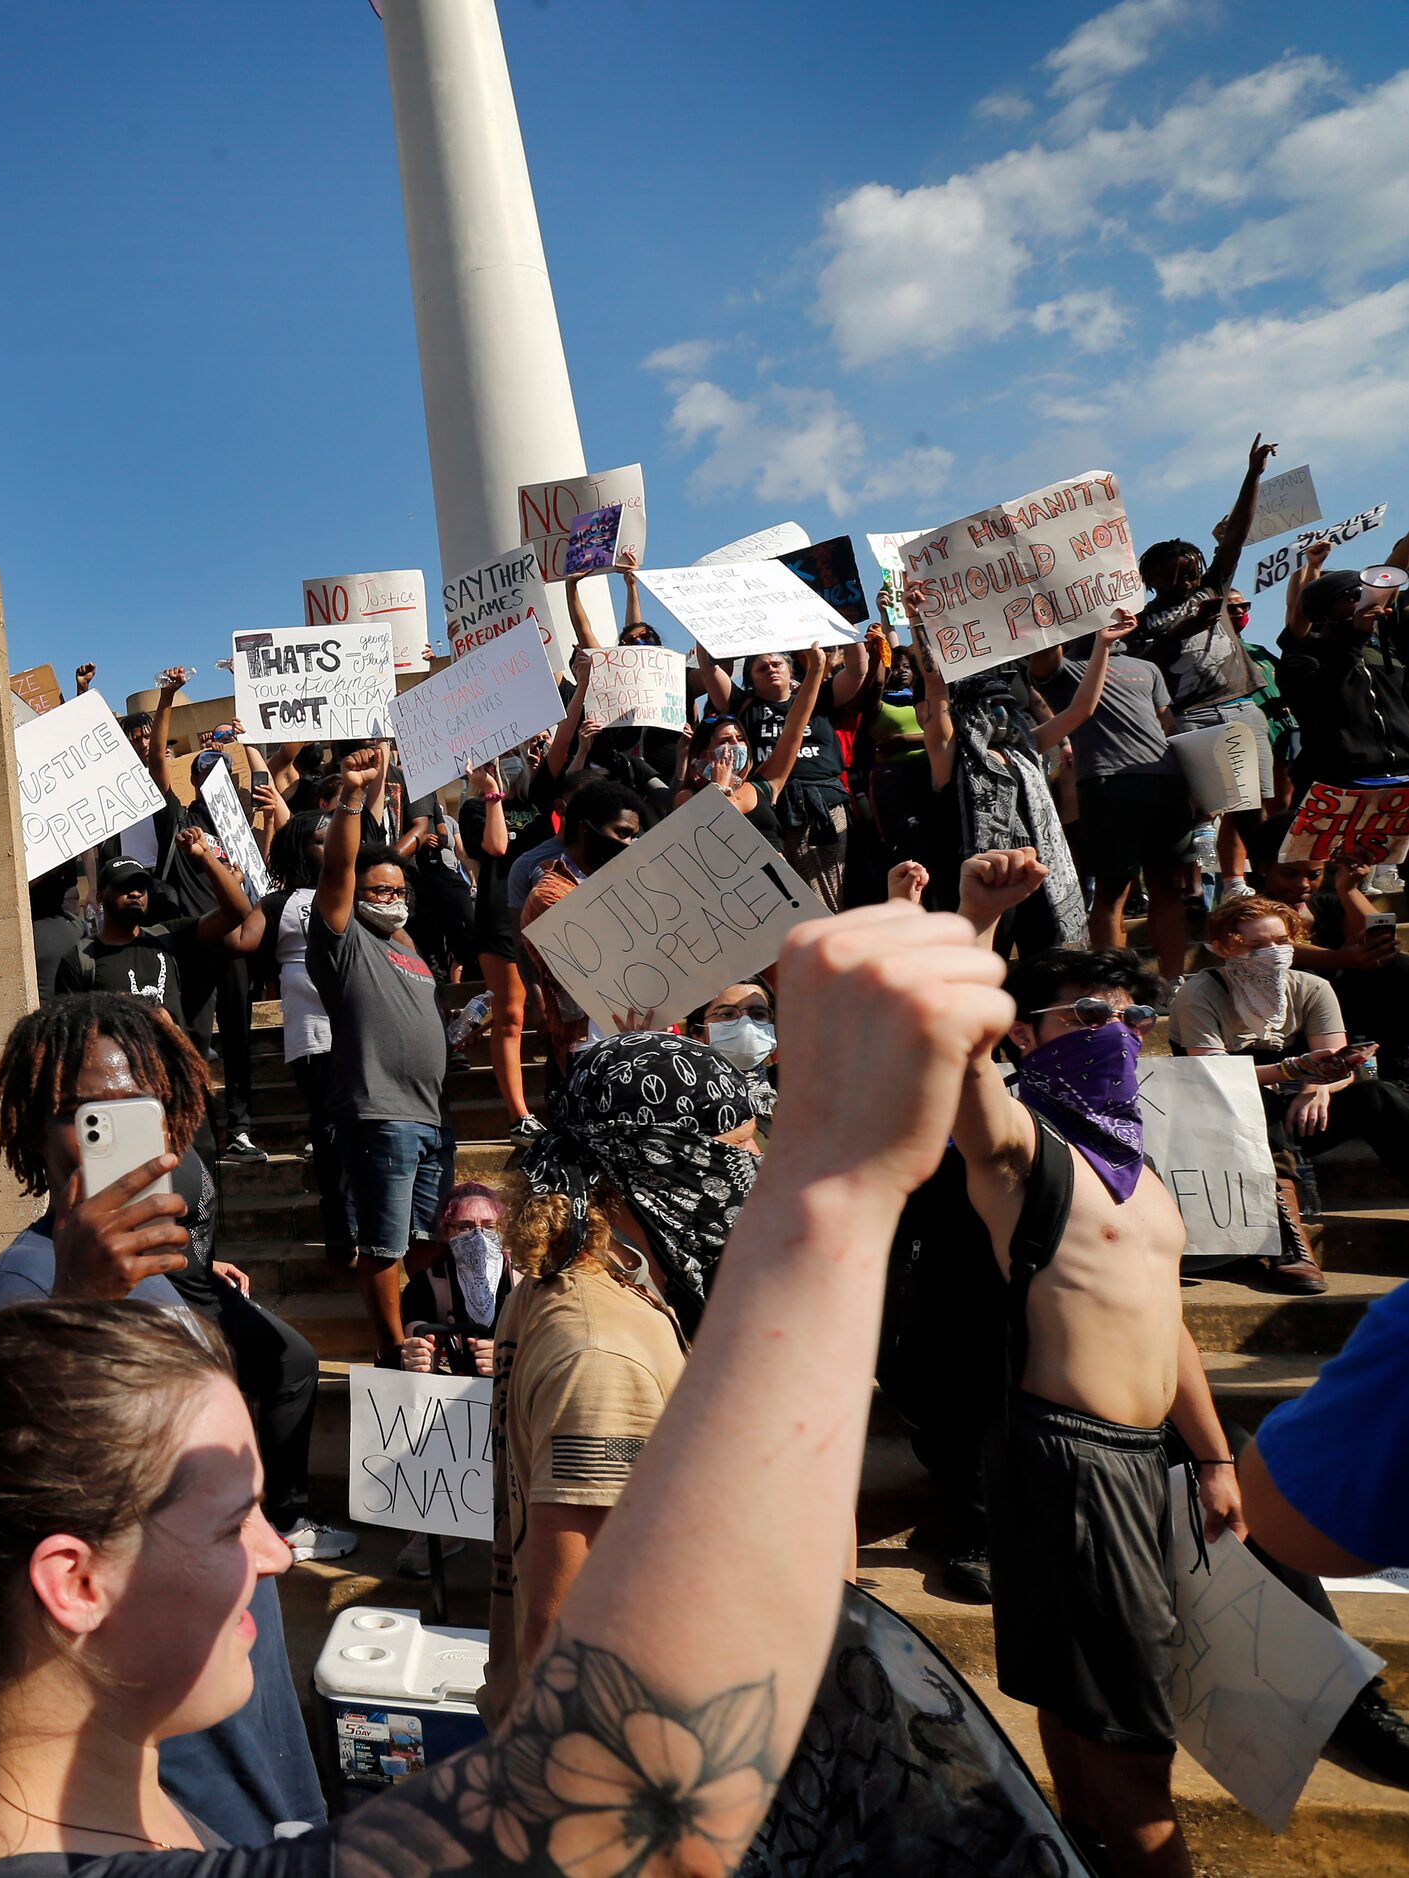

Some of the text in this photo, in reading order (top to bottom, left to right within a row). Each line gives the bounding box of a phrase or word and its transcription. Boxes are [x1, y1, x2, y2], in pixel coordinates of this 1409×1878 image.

[1260, 470, 1308, 497] EMAND
[522, 486, 579, 539] NO
[909, 474, 1114, 572] MY HUMANITY
[918, 544, 1056, 618] SHOULD
[1069, 516, 1128, 562] NOT
[1255, 561, 1289, 594] NO
[1258, 547, 1289, 576] NO
[306, 579, 416, 625] NO Justice
[444, 569, 484, 613] SAY
[673, 581, 736, 599] THOUGHT
[744, 578, 768, 591] AN
[699, 598, 736, 613] LIVES
[741, 590, 793, 609] MATTER
[461, 589, 524, 630] NAMES
[685, 609, 768, 632] BITCH SAID
[235, 633, 341, 679] THATS
[591, 649, 672, 674] PROTECT
[936, 620, 991, 664] BE
[248, 683, 293, 698] YOUR
[396, 707, 437, 740] BLACK
[492, 650, 530, 686] LIVES
[397, 653, 487, 717] BLACK LIVES
[591, 668, 645, 691] BLACK
[596, 688, 656, 709] PEOPLE
[259, 697, 327, 730] FOOT
[334, 693, 356, 707] ON
[330, 706, 394, 738] NECK
[402, 692, 503, 761] BLACK GAY LIVES
[16, 722, 120, 803] USTICE
[407, 750, 443, 778] BLACK
[47, 763, 162, 860] PEACE
[539, 811, 760, 991] NO JUSTICE
[596, 962, 669, 1017] NO
[345, 1724, 356, 1736] 5
